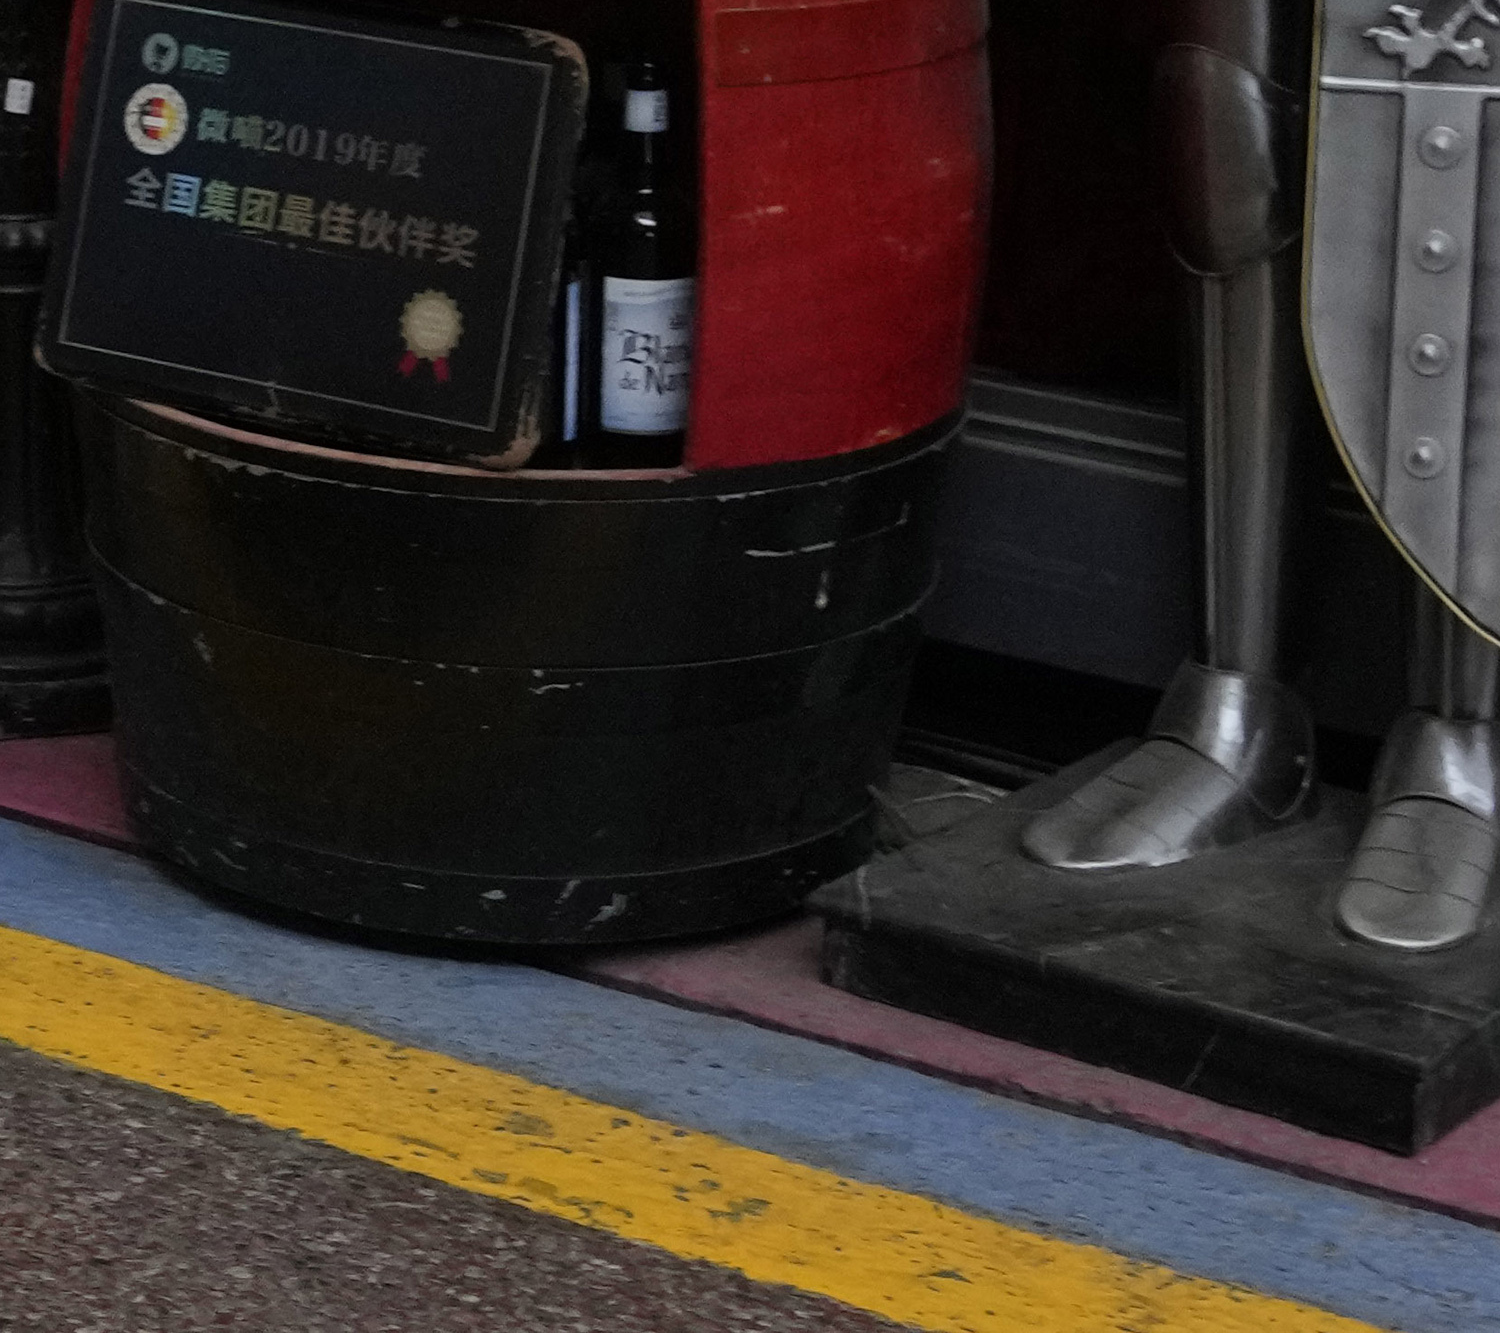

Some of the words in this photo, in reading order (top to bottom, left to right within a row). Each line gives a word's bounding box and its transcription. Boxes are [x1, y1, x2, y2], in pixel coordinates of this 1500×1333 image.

[123, 166, 481, 269] 全国集团最佳伙伴奖
